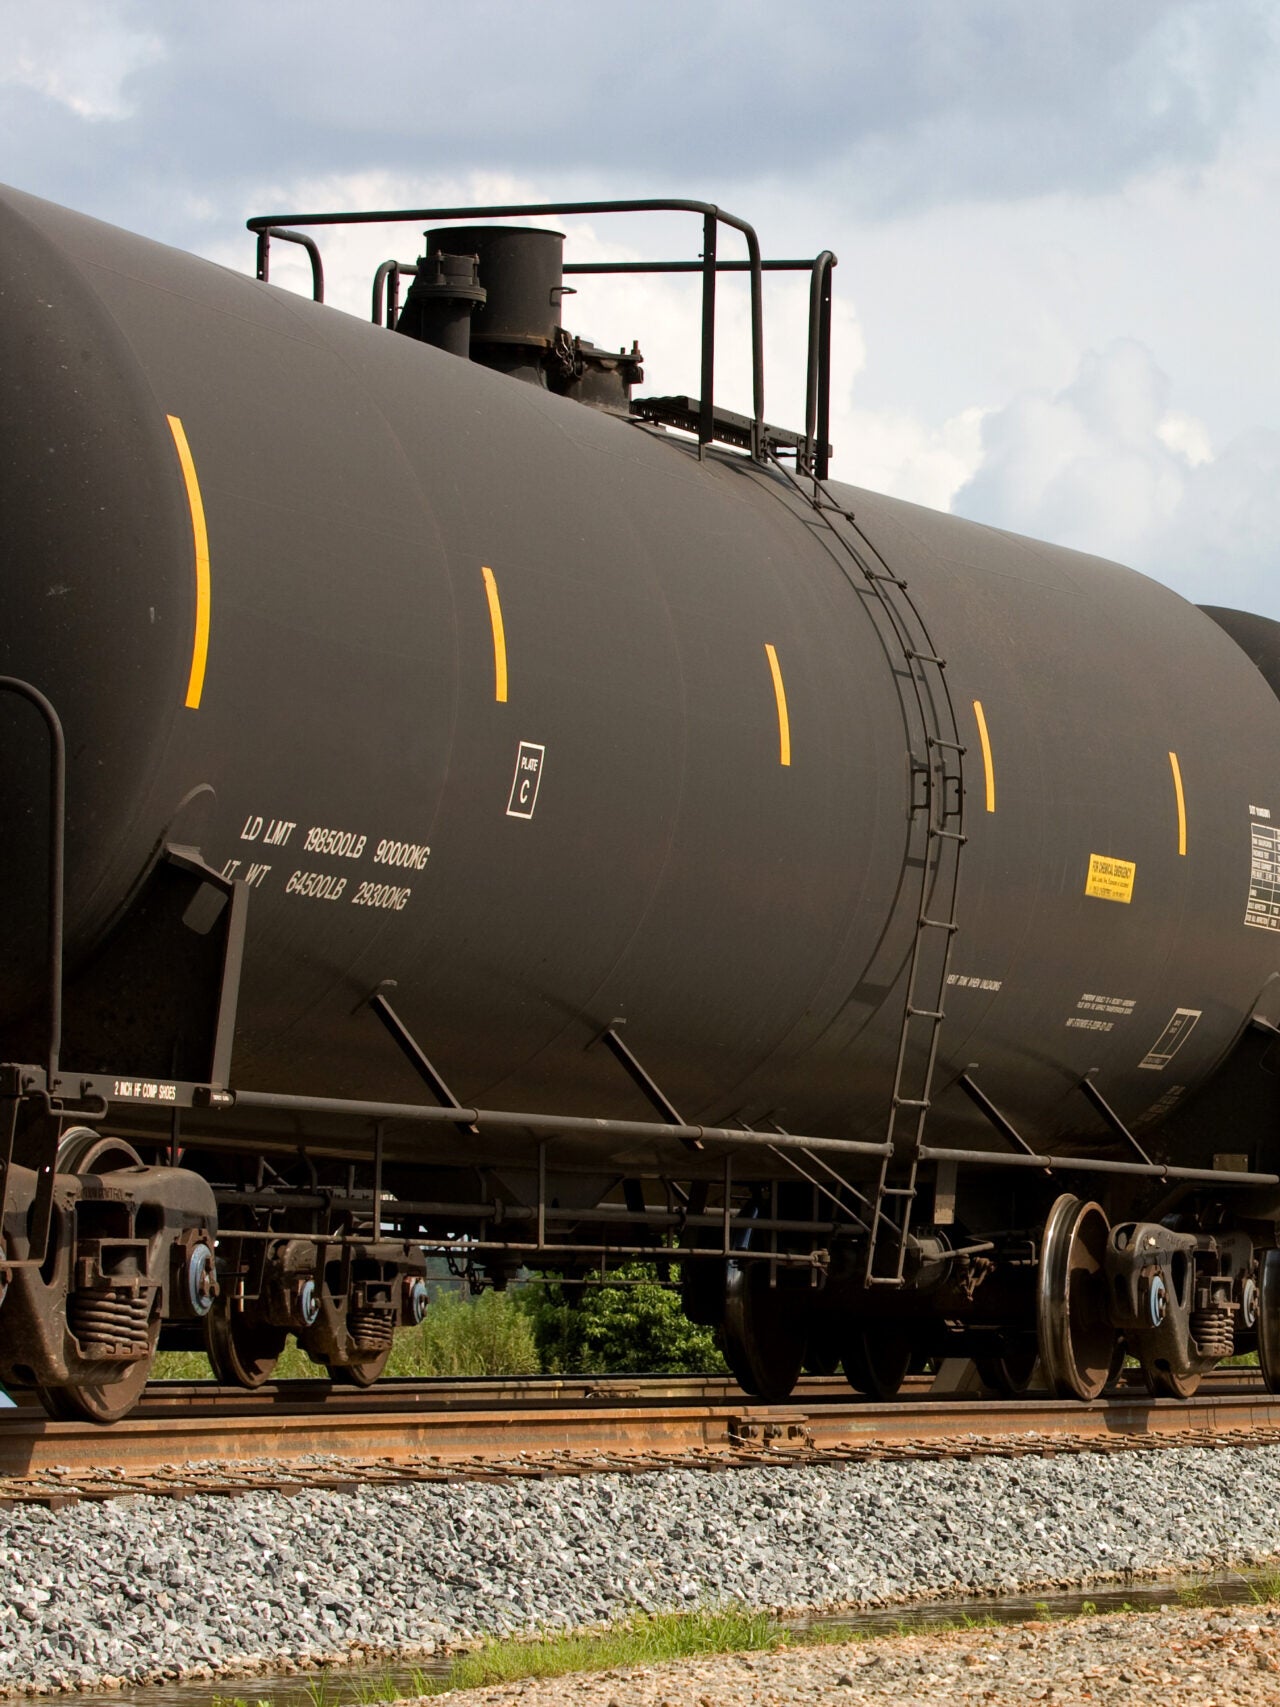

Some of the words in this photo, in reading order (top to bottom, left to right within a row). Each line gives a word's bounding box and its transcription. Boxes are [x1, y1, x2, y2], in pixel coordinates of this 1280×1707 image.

[521, 757, 539, 771] PLATE
[520, 780, 530, 804] C
[240, 815, 263, 841] LD
[263, 819, 297, 846] LMT
[303, 827, 368, 859] 198500LB
[373, 839, 431, 870] 90000KG
[245, 863, 272, 888] WT
[285, 870, 348, 900] 64500LB
[351, 881, 412, 910] 29300KG
[114, 1081, 119, 1095] 2
[120, 1081, 133, 1096] INCH
[133, 1082, 142, 1097] HF
[142, 1083, 158, 1099] COMP
[158, 1084, 177, 1100] SHOES
